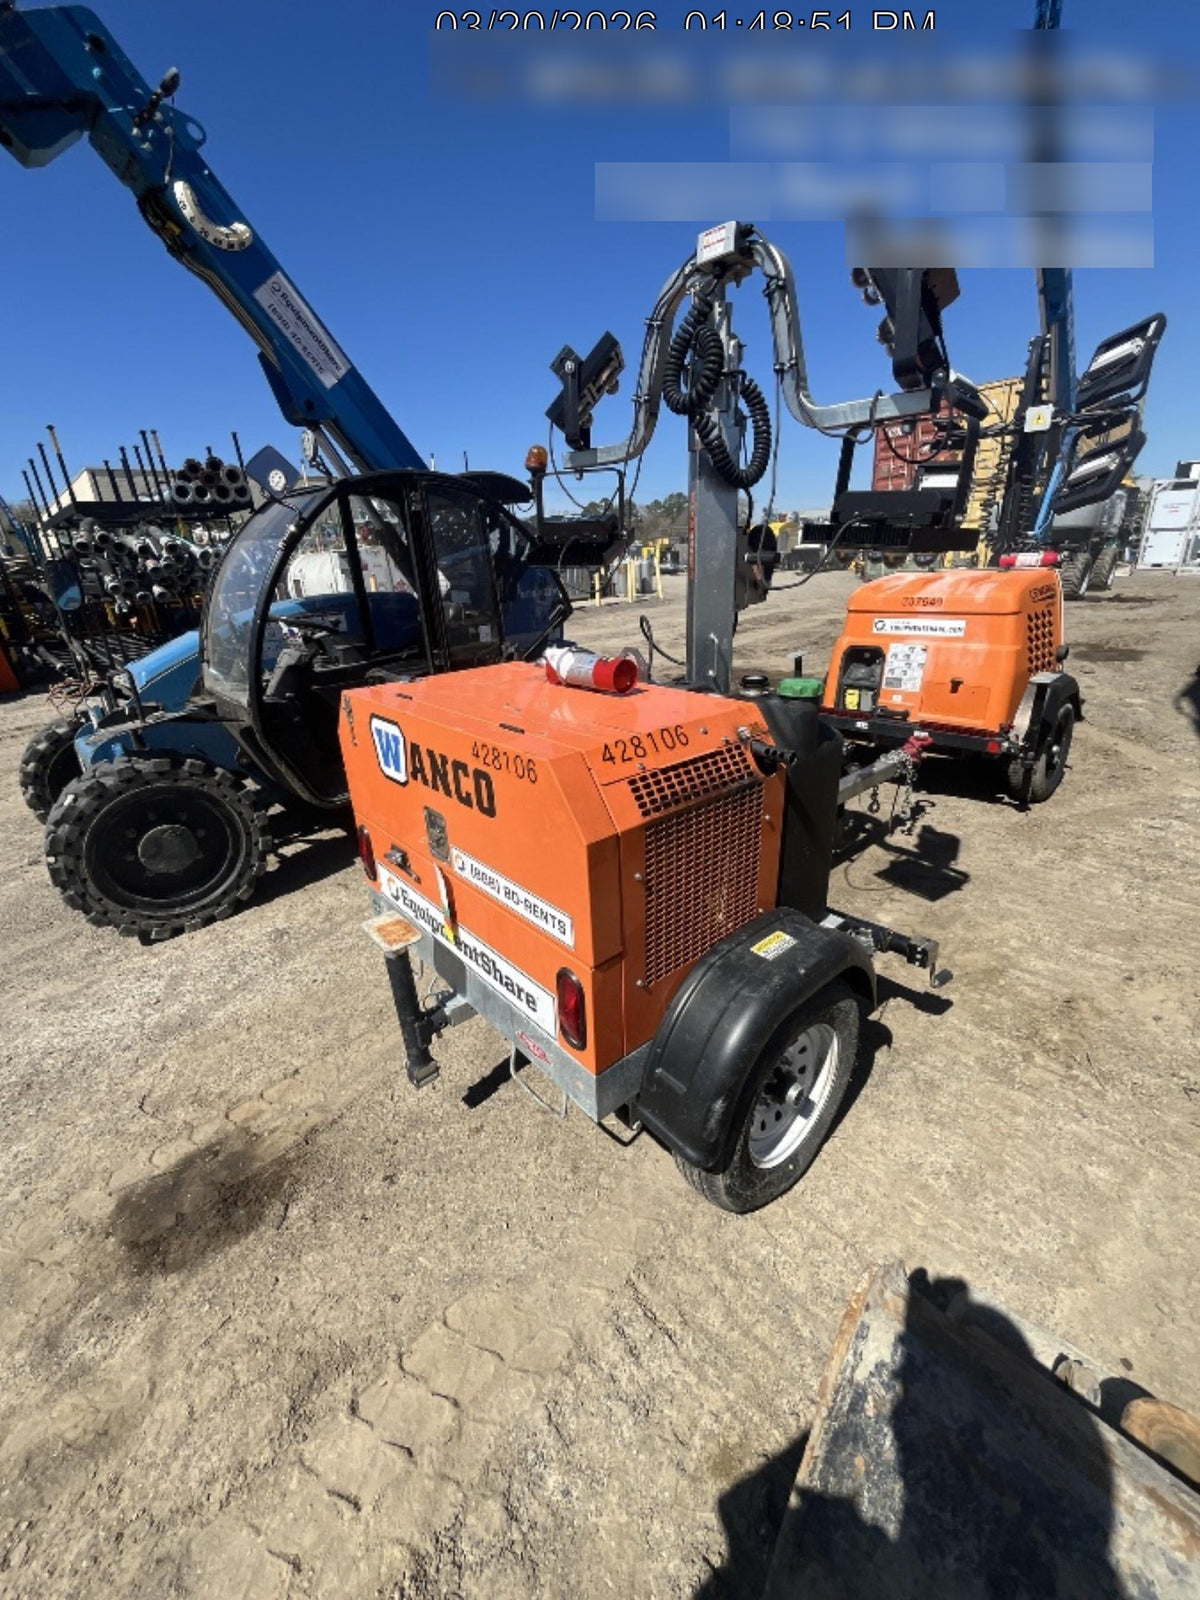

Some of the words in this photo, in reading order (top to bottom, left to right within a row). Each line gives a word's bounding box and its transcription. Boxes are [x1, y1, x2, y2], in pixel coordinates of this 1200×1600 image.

[472, 741, 538, 785] 428106
[602, 725, 689, 765] 428106
[372, 724, 497, 818] WANCO
[503, 886, 566, 936] 80-RENTS
